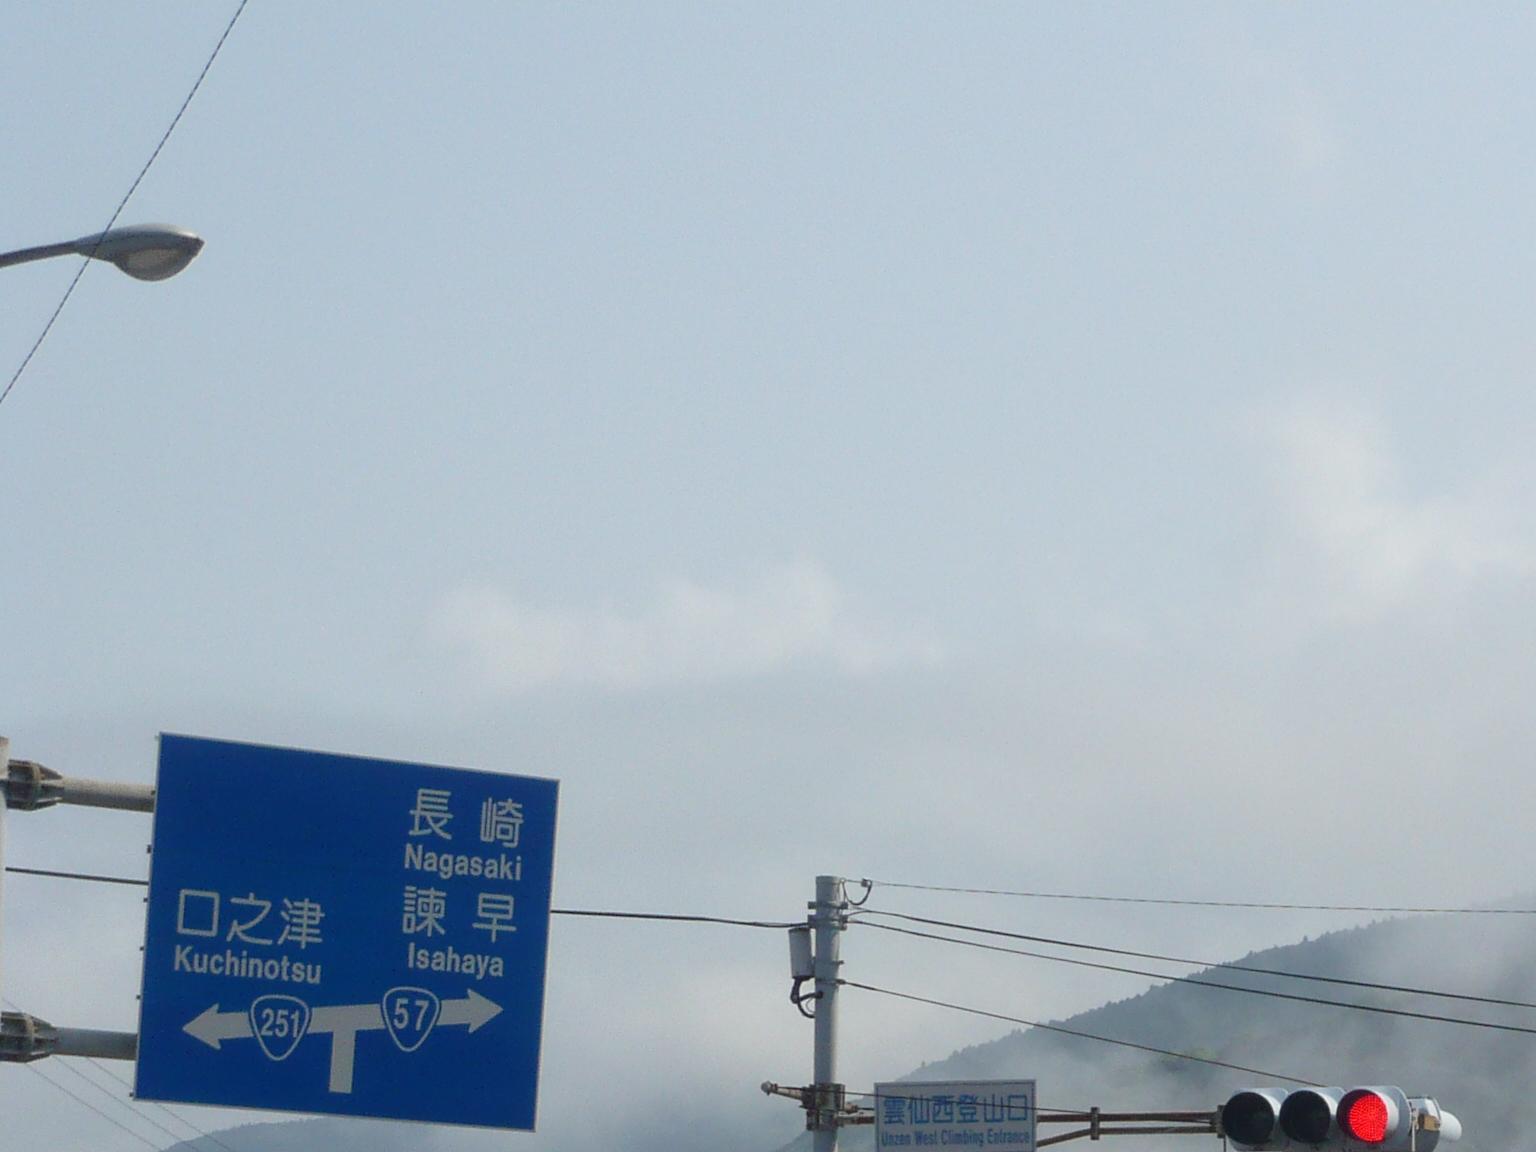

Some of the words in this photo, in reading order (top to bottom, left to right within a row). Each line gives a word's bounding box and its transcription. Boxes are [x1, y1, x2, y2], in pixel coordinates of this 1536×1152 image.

[408, 789, 524, 848] 長崎
[404, 843, 522, 881] Nagasaki
[177, 889, 325, 949] 口之津
[402, 886, 517, 943] 諫早
[174, 945, 322, 984] Kuchinotsu
[408, 942, 504, 981] Isahaya
[260, 1007, 300, 1039] 251
[393, 998, 430, 1032] 57
[883, 1094, 1029, 1126] 雲仙西登山口
[881, 1130, 912, 1147] Unzen
[914, 1129, 937, 1146] West
[941, 1129, 985, 1148] Climbing
[987, 1128, 1030, 1145] Entrance
